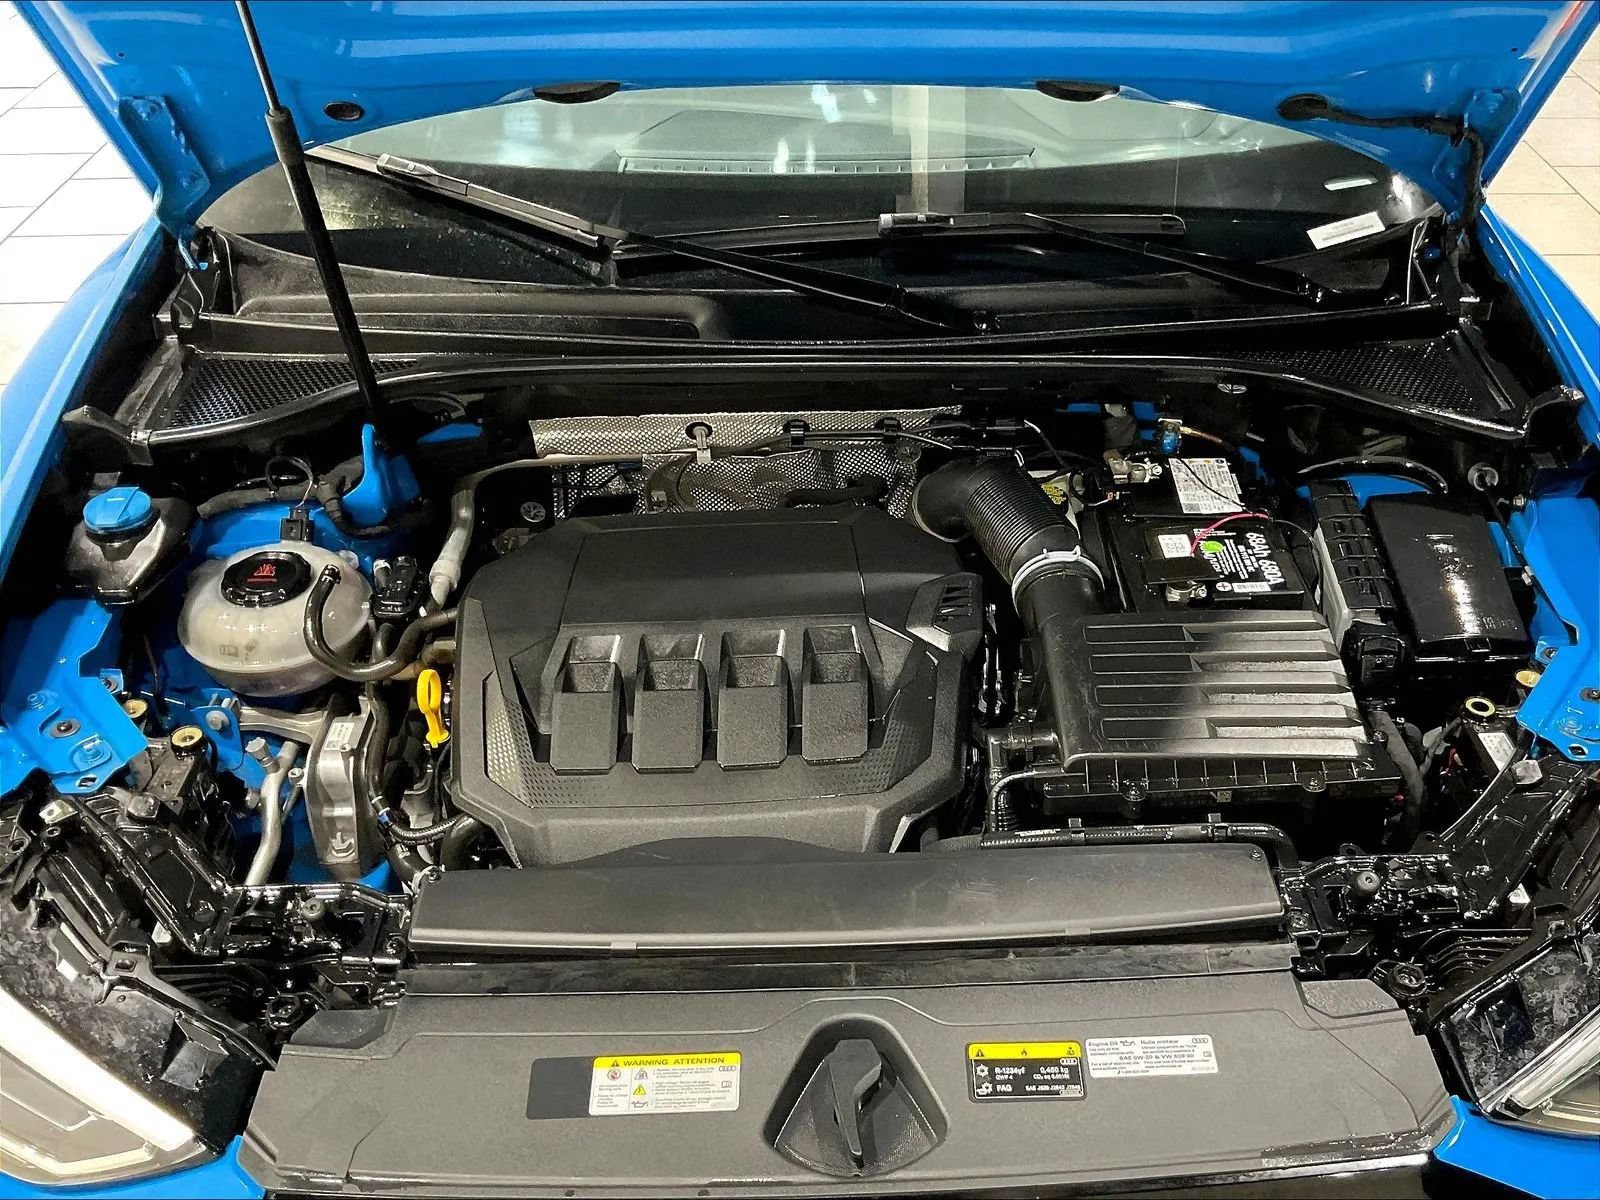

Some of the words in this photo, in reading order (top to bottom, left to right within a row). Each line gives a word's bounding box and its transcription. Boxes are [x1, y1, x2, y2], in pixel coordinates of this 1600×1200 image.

[1245, 532, 1271, 557] 68Ah
[1258, 559, 1285, 585] 680A
[994, 1066, 1025, 1075] R-1234yf
[1060, 1066, 1068, 1074] kg
[996, 1084, 1013, 1092] PAG
